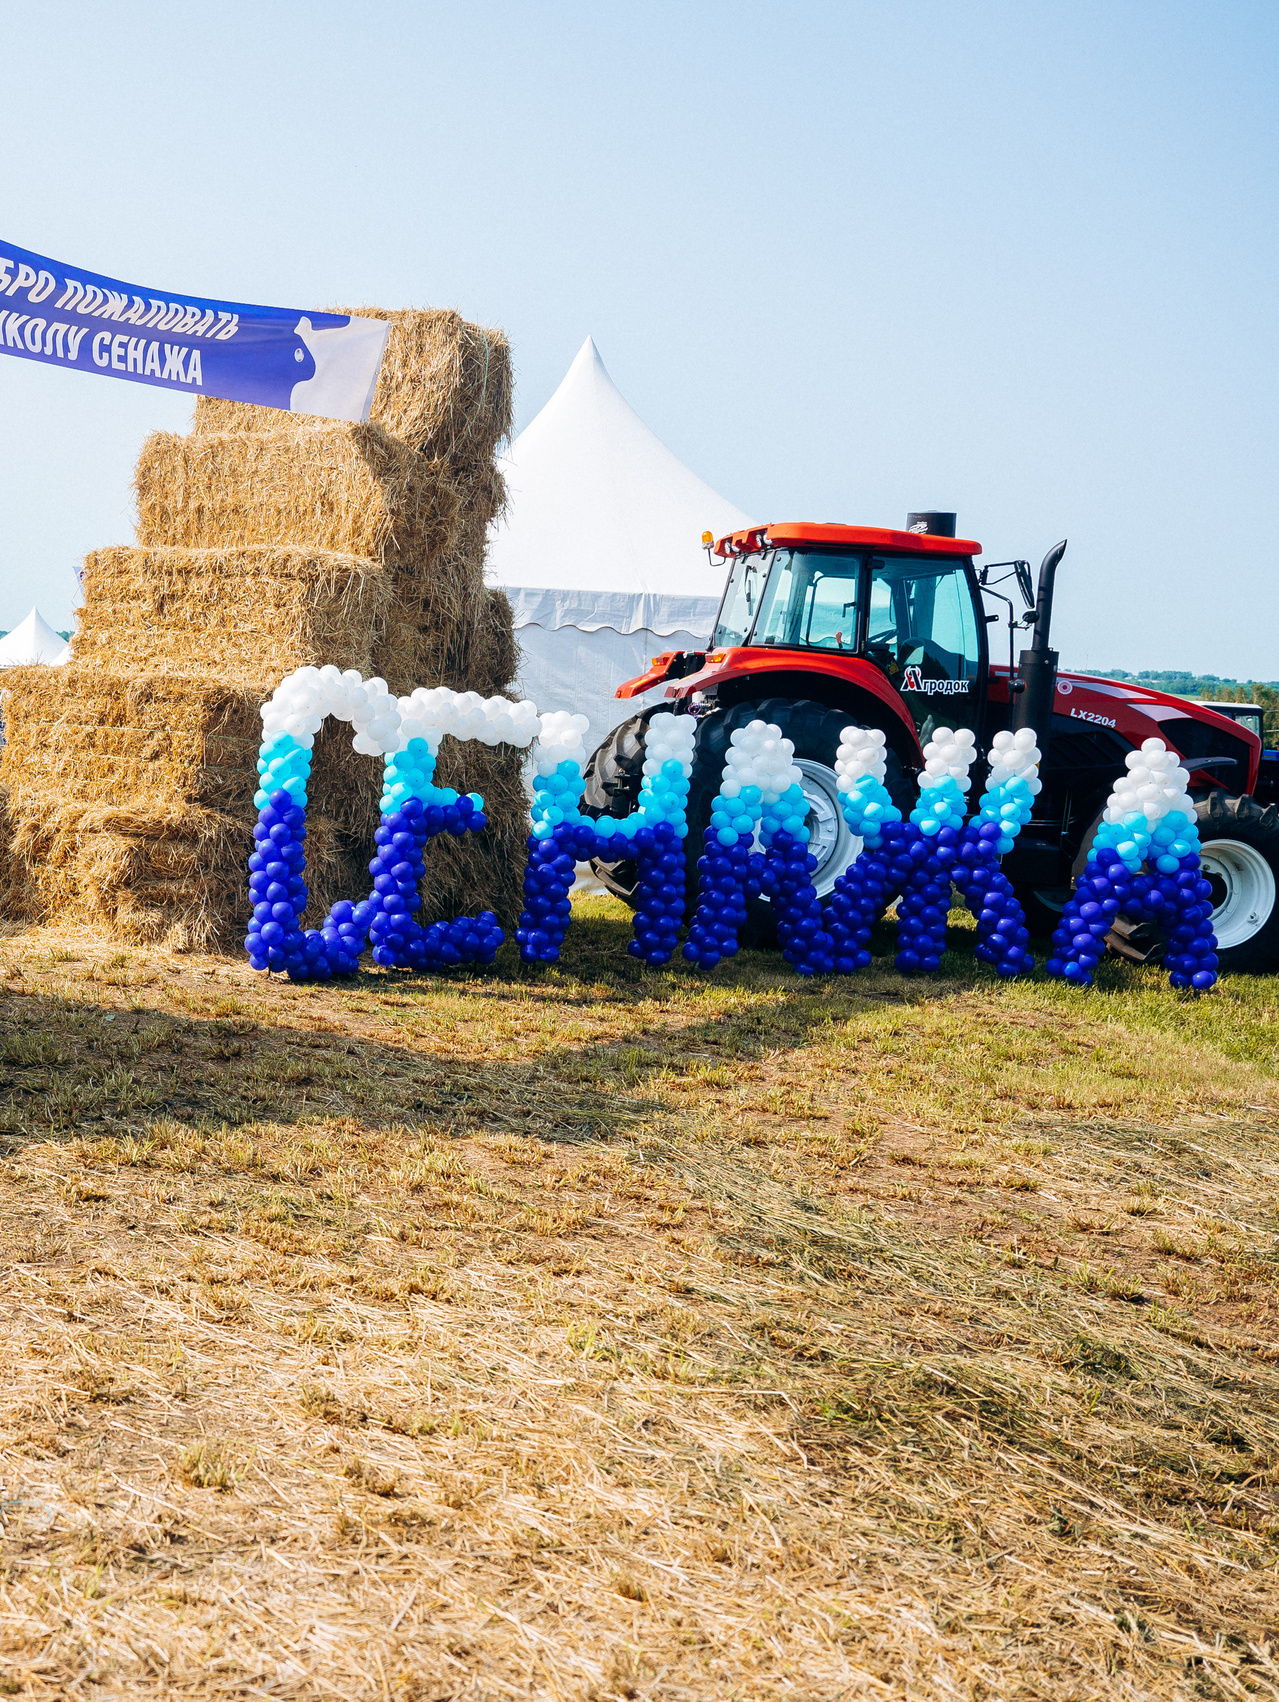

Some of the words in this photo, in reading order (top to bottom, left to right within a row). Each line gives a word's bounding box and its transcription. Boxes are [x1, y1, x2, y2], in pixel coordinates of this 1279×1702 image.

[54, 279, 239, 341] ПОЖАЛОВАТЬ
[92, 332, 203, 386] СЕНАЖА
[900, 665, 970, 695] Агродок
[1070, 707, 1117, 729] LX2204
[244, 664, 1220, 992] СЕНАЖА
